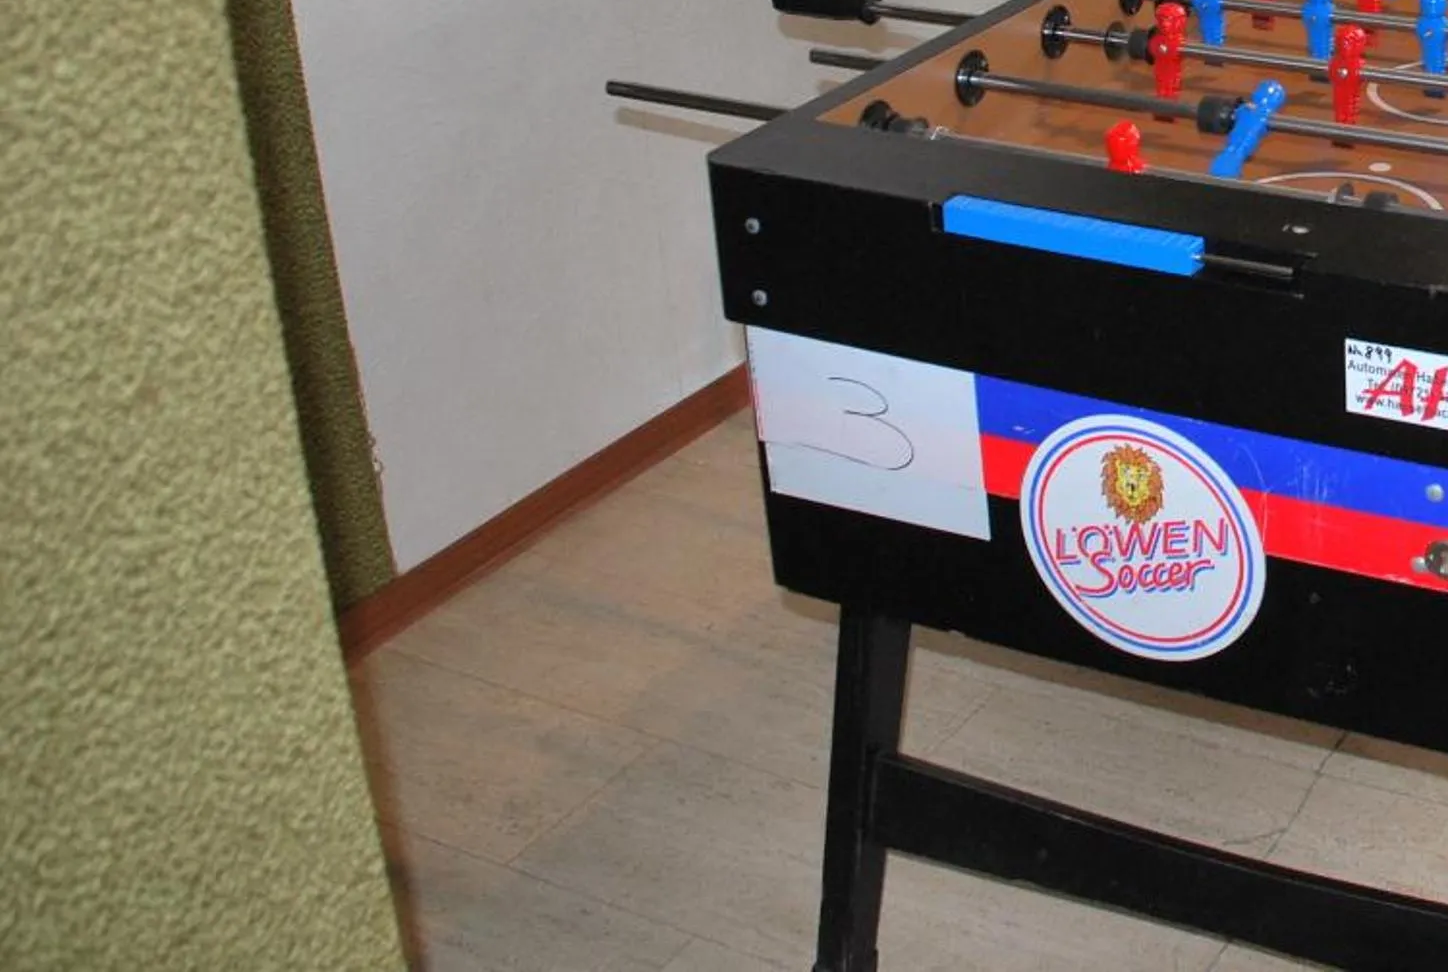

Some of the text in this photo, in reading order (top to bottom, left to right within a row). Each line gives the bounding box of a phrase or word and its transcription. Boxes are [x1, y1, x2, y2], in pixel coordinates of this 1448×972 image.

[799, 376, 915, 471] 3
[1055, 518, 1229, 565] LÖWEN
[1074, 551, 1216, 599] Soccer
